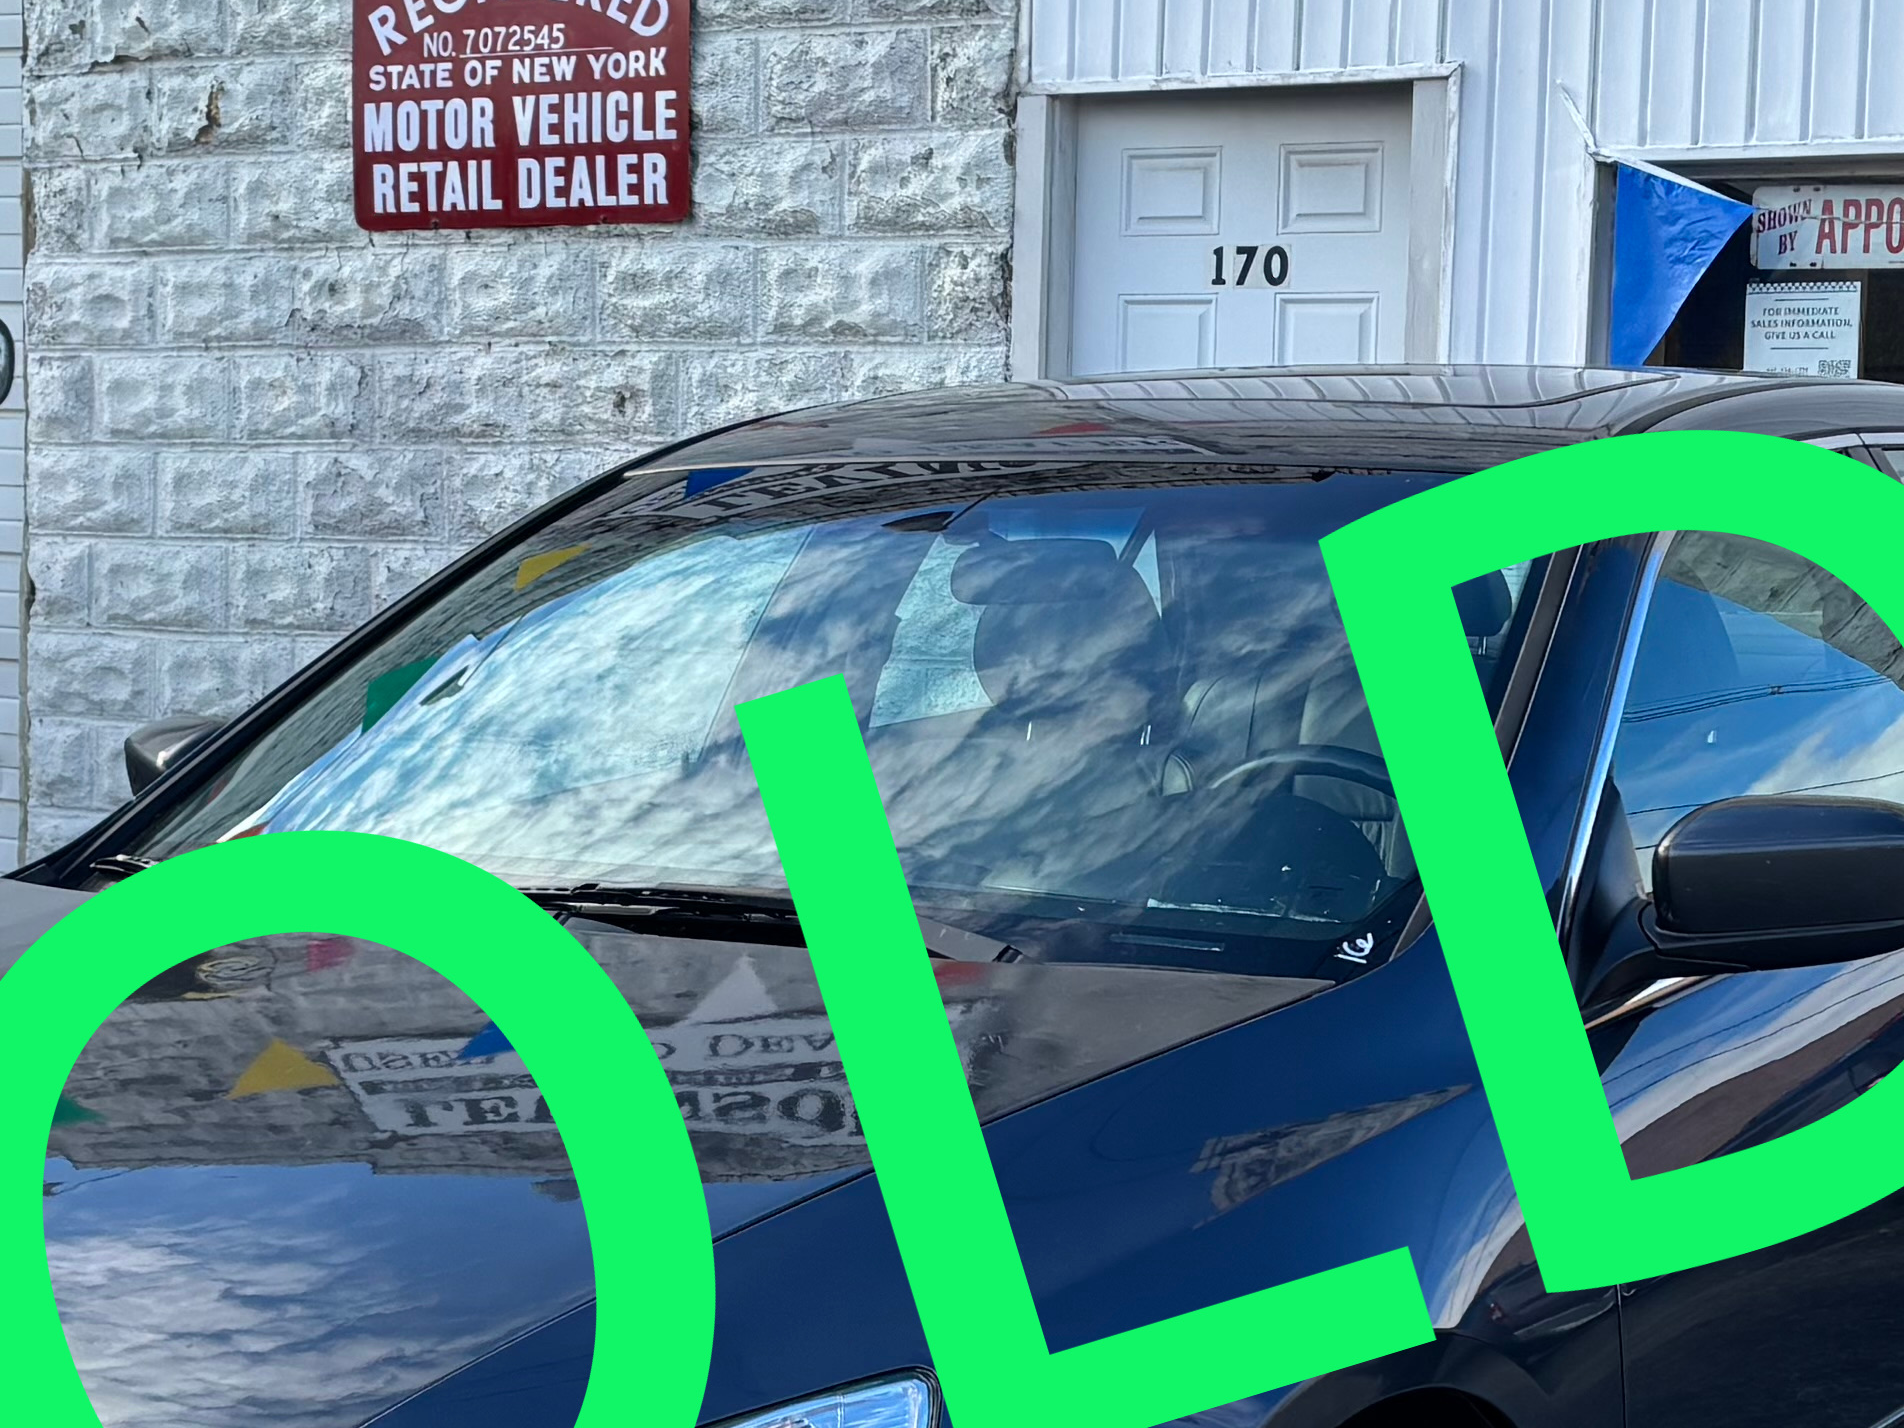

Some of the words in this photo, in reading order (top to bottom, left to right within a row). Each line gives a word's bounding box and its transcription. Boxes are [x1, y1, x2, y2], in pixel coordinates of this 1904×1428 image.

[423, 32, 456, 58] NO.
[464, 23, 566, 54] 7072545
[369, 62, 453, 91] STATE
[464, 59, 499, 87] OF
[512, 55, 577, 84] NEW
[586, 47, 668, 80] YORK
[363, 97, 496, 153] MOTOR
[511, 90, 677, 146] VEHICLE
[372, 159, 502, 214] RETAIL
[517, 153, 668, 209] DEALER
[1756, 198, 1813, 234] SHOWN
[1778, 231, 1798, 256] BY
[1211, 245, 1289, 286] 170
[1751, 319, 1779, 329] SALES
[1784, 306, 1840, 316] IMMEDIATE
[1764, 332, 1786, 341] GIVE
[1812, 330, 1836, 340] CALL
